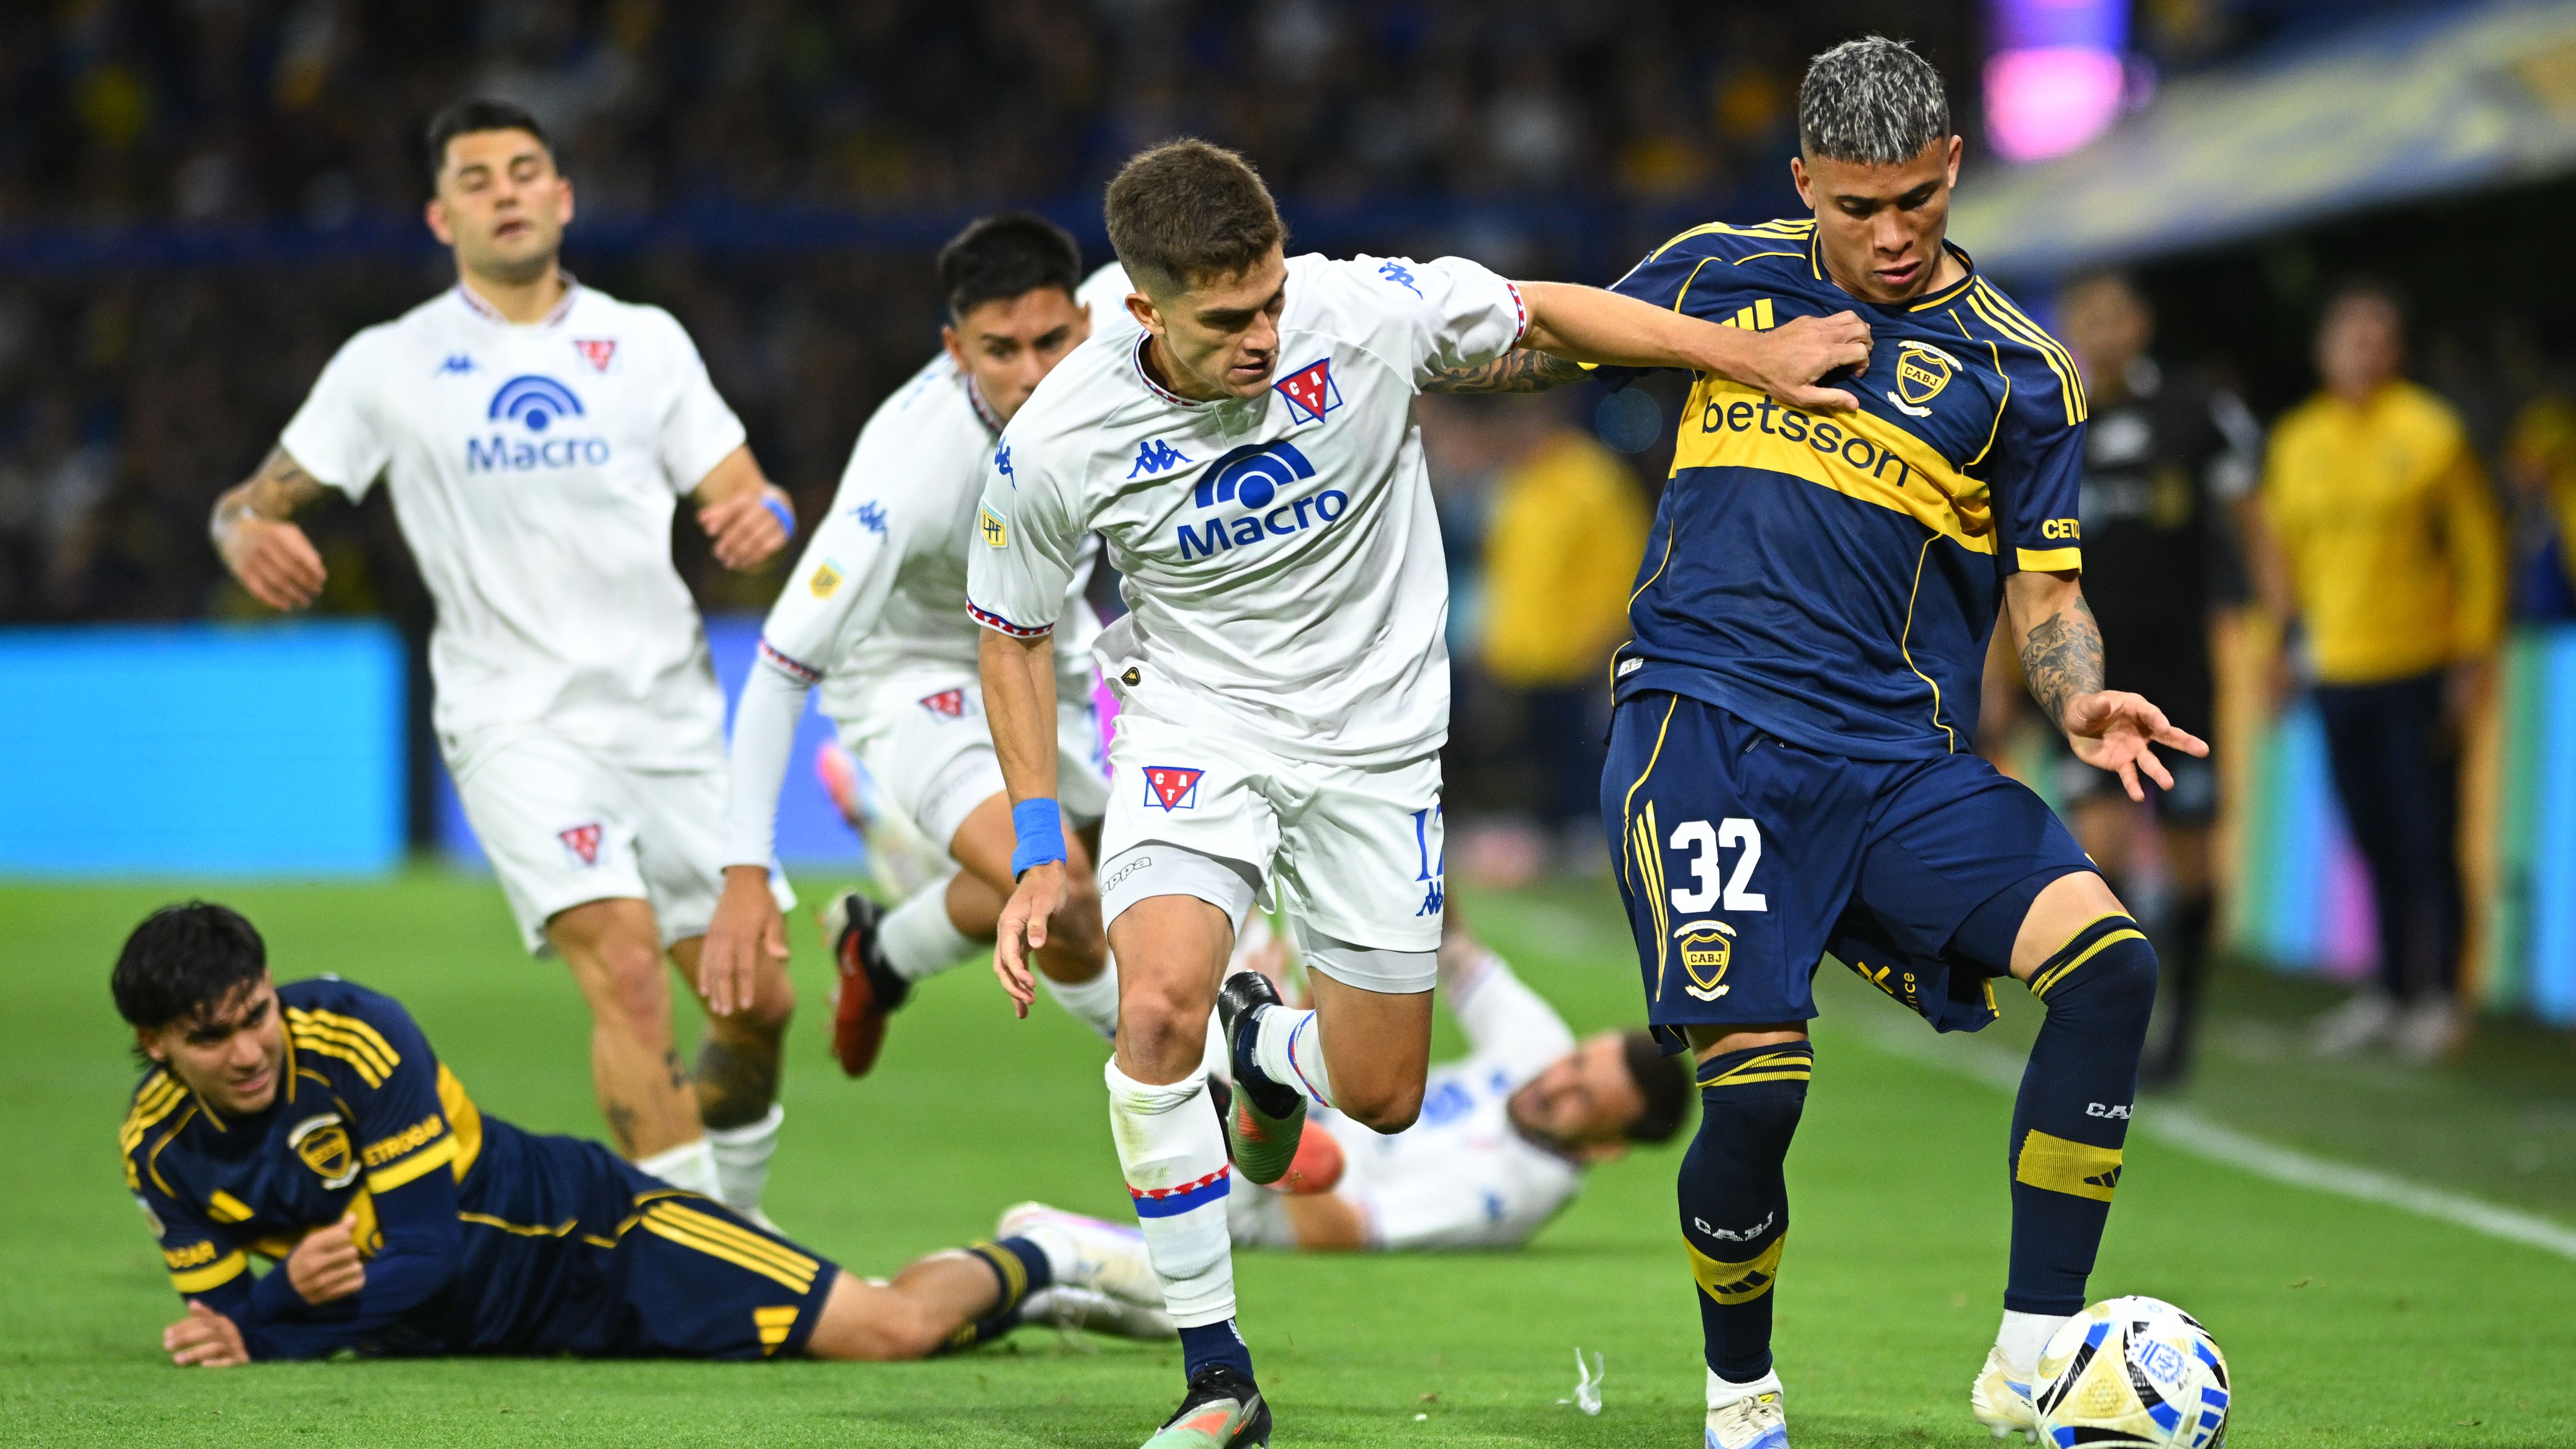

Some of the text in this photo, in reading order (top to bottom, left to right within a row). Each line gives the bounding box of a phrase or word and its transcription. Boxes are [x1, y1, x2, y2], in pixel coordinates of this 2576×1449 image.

[1904, 366, 1939, 386] CABJ
[466, 436, 611, 475] Macro
[1701, 394, 1911, 488] betsson
[1176, 489, 1349, 560] Macro
[1101, 857, 1152, 897] appa
[1669, 817, 1768, 914] 32
[1690, 953, 1722, 963] CABJ
[2085, 1102, 2133, 1119] CA
[362, 1114, 443, 1166] ETROGAR
[1694, 1211, 1773, 1242] CABJ
